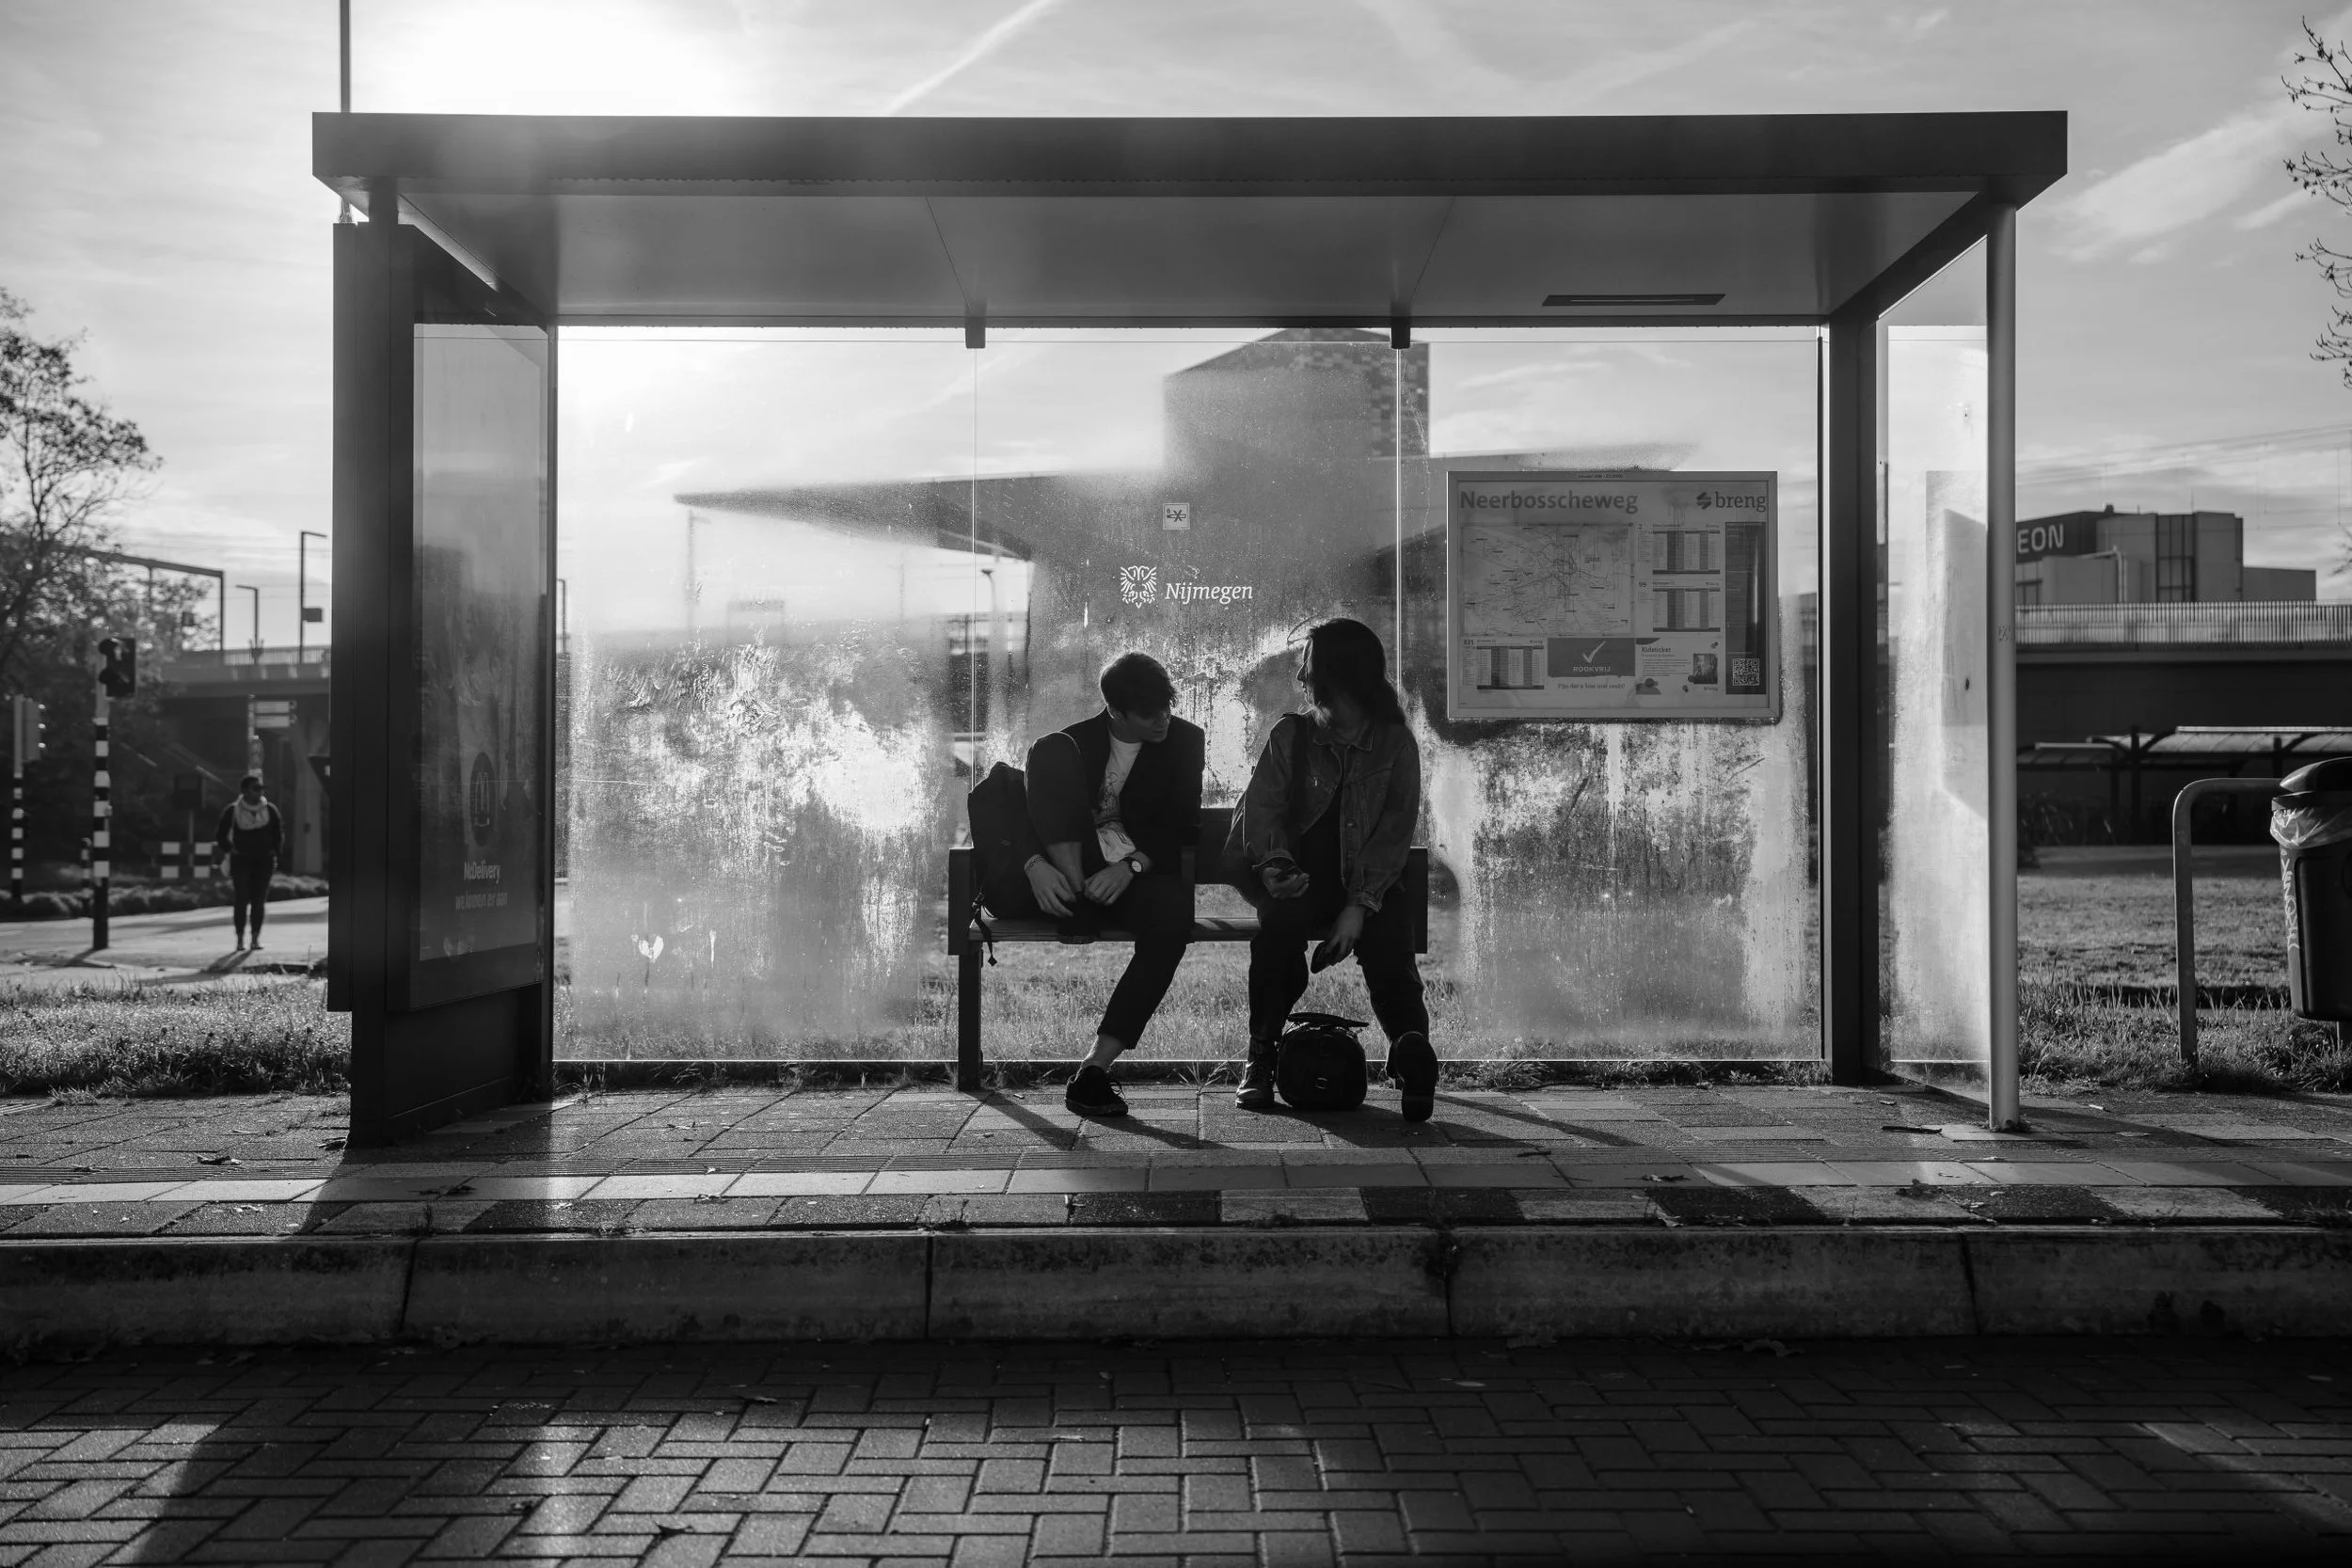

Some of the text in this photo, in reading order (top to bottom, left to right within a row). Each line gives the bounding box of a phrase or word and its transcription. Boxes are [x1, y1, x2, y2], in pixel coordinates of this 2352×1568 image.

[1460, 490, 1638, 515] Neerbosscheweg
[1715, 491, 1766, 513] breng
[2017, 523, 2064, 553] EON
[1165, 582, 1253, 605] Nijmegen
[464, 861, 501, 883] McDelivery
